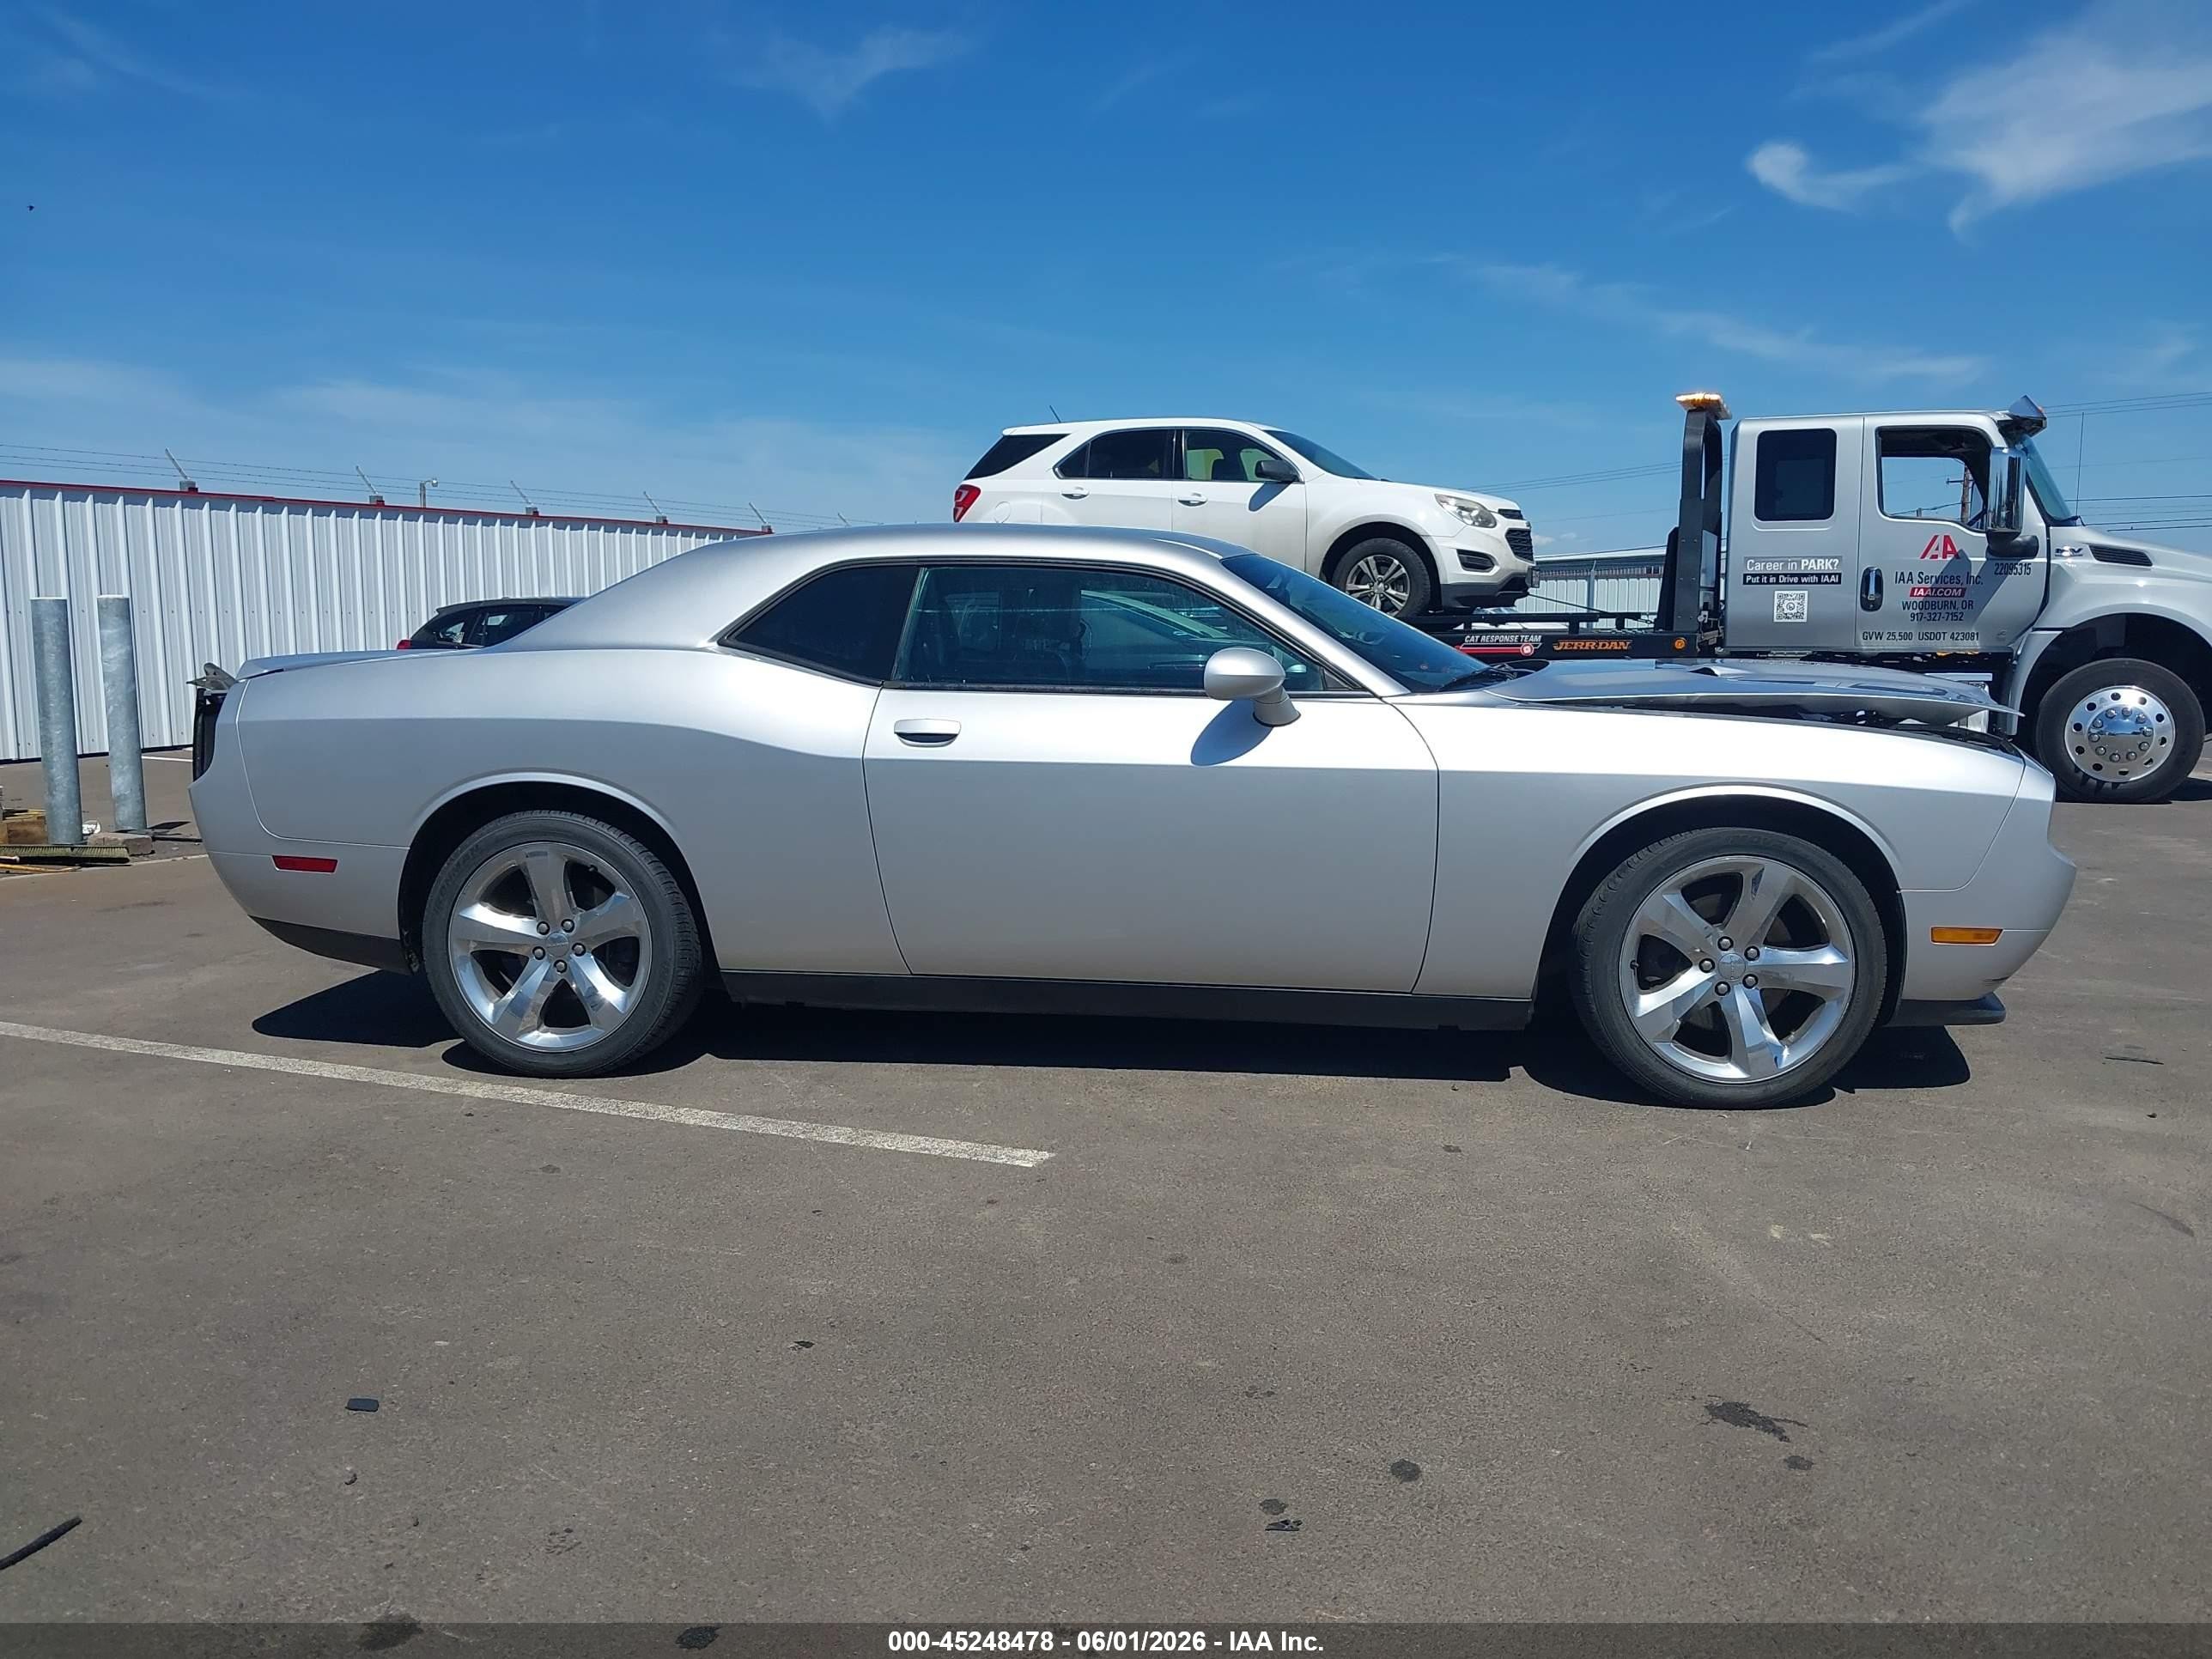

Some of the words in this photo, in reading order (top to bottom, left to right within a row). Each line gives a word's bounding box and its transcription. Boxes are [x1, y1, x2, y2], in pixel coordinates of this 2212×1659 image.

[1747, 559, 1785, 571] Career
[1788, 559, 1797, 570] in
[1801, 558, 1839, 570] PARK?
[1994, 563, 2032, 575] 22095315
[1820, 574, 1839, 583] IAAI
[1894, 572, 1914, 584] IAA
[1917, 572, 1963, 586] Services,
[1966, 573, 1984, 585] Inc.
[1913, 588, 1962, 597] IAAI.COM
[1902, 601, 1959, 611] WOODBURN,
[1961, 601, 1974, 611] OR
[1910, 612, 1964, 622] 917-327-7152
[1862, 631, 1884, 641] GVW
[1887, 631, 1913, 642] 25,500
[1917, 632, 1948, 641] USDOT
[1949, 632, 1979, 641] 423081
